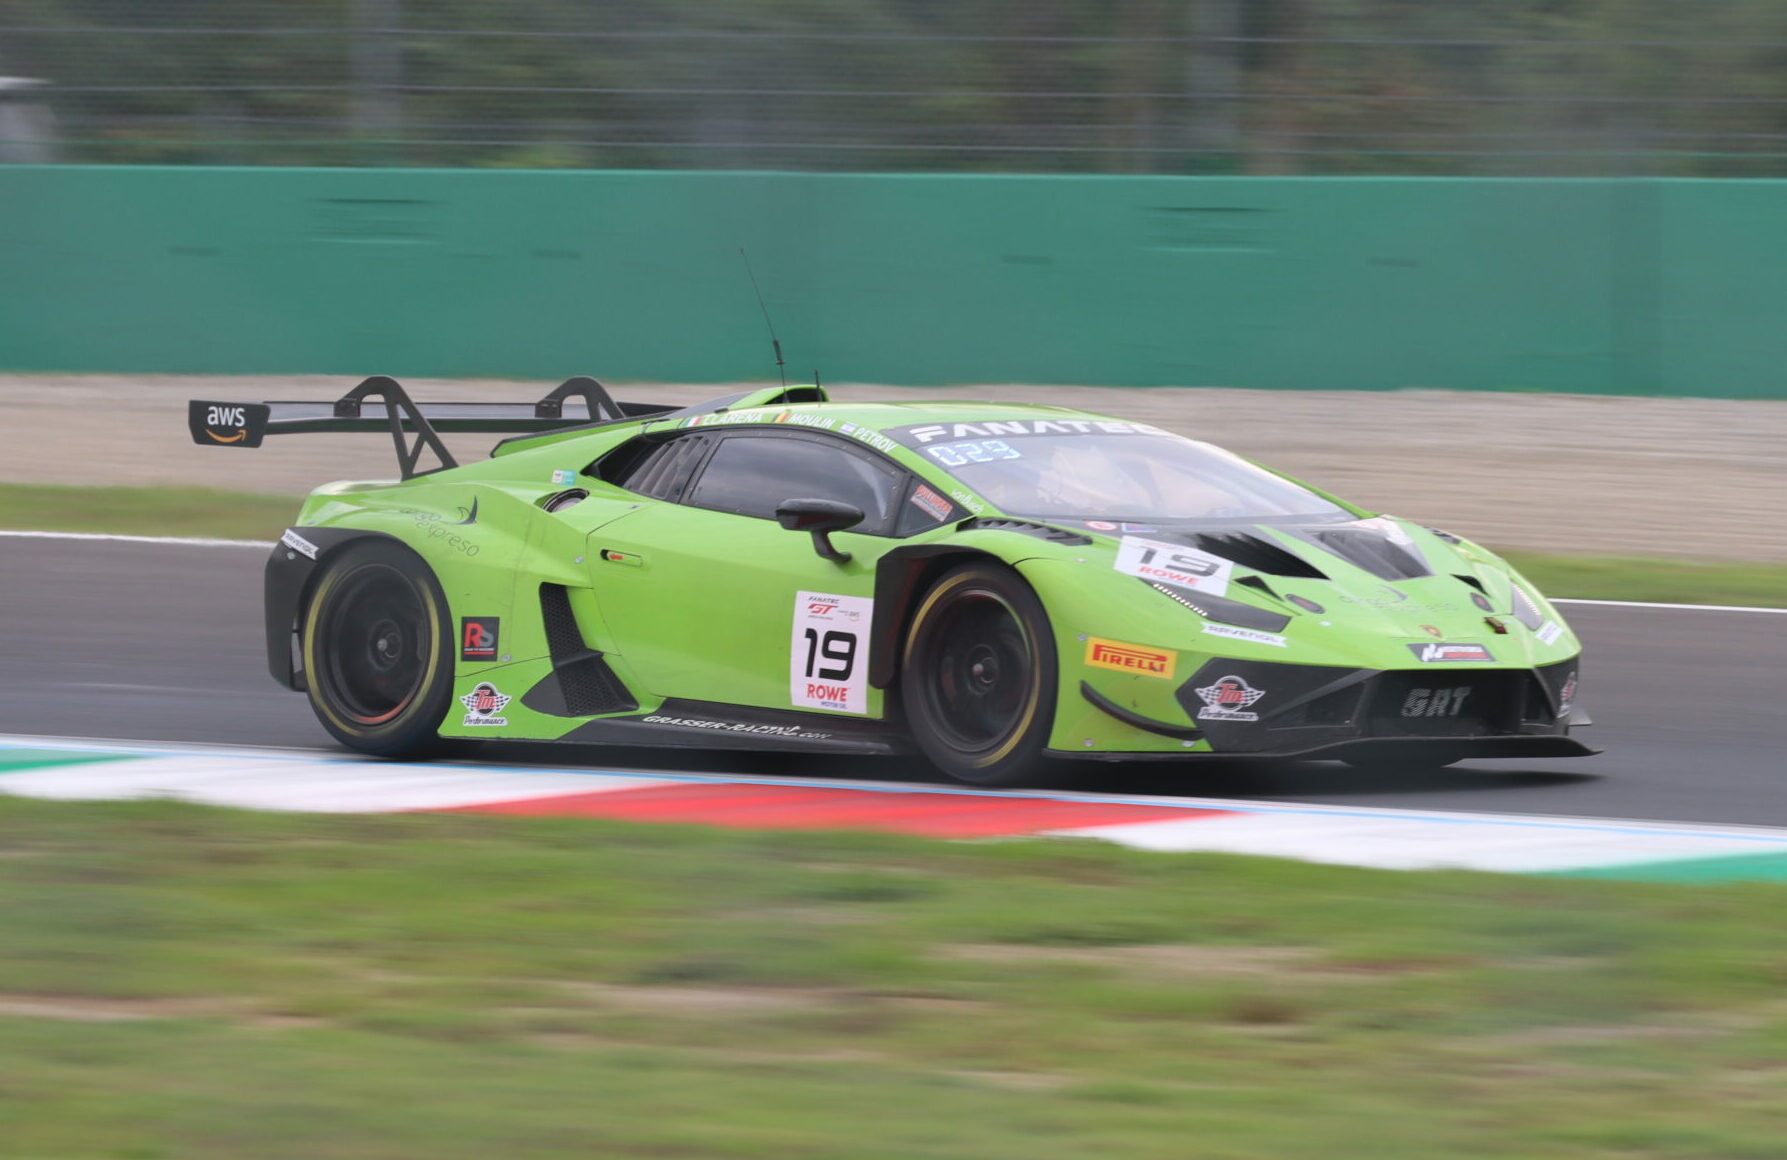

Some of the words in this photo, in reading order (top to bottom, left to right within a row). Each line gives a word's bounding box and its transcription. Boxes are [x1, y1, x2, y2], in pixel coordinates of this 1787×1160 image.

[207, 405, 246, 427] aws
[789, 412, 836, 429] MOULIN
[852, 427, 899, 453] PETROV
[1137, 545, 1222, 577] 19
[1137, 565, 1199, 585] ROWE
[807, 602, 839, 615] GT
[464, 622, 495, 648] RS
[804, 627, 858, 682] 19
[1092, 643, 1169, 674] PIRELLI
[806, 683, 849, 702] ROWE
